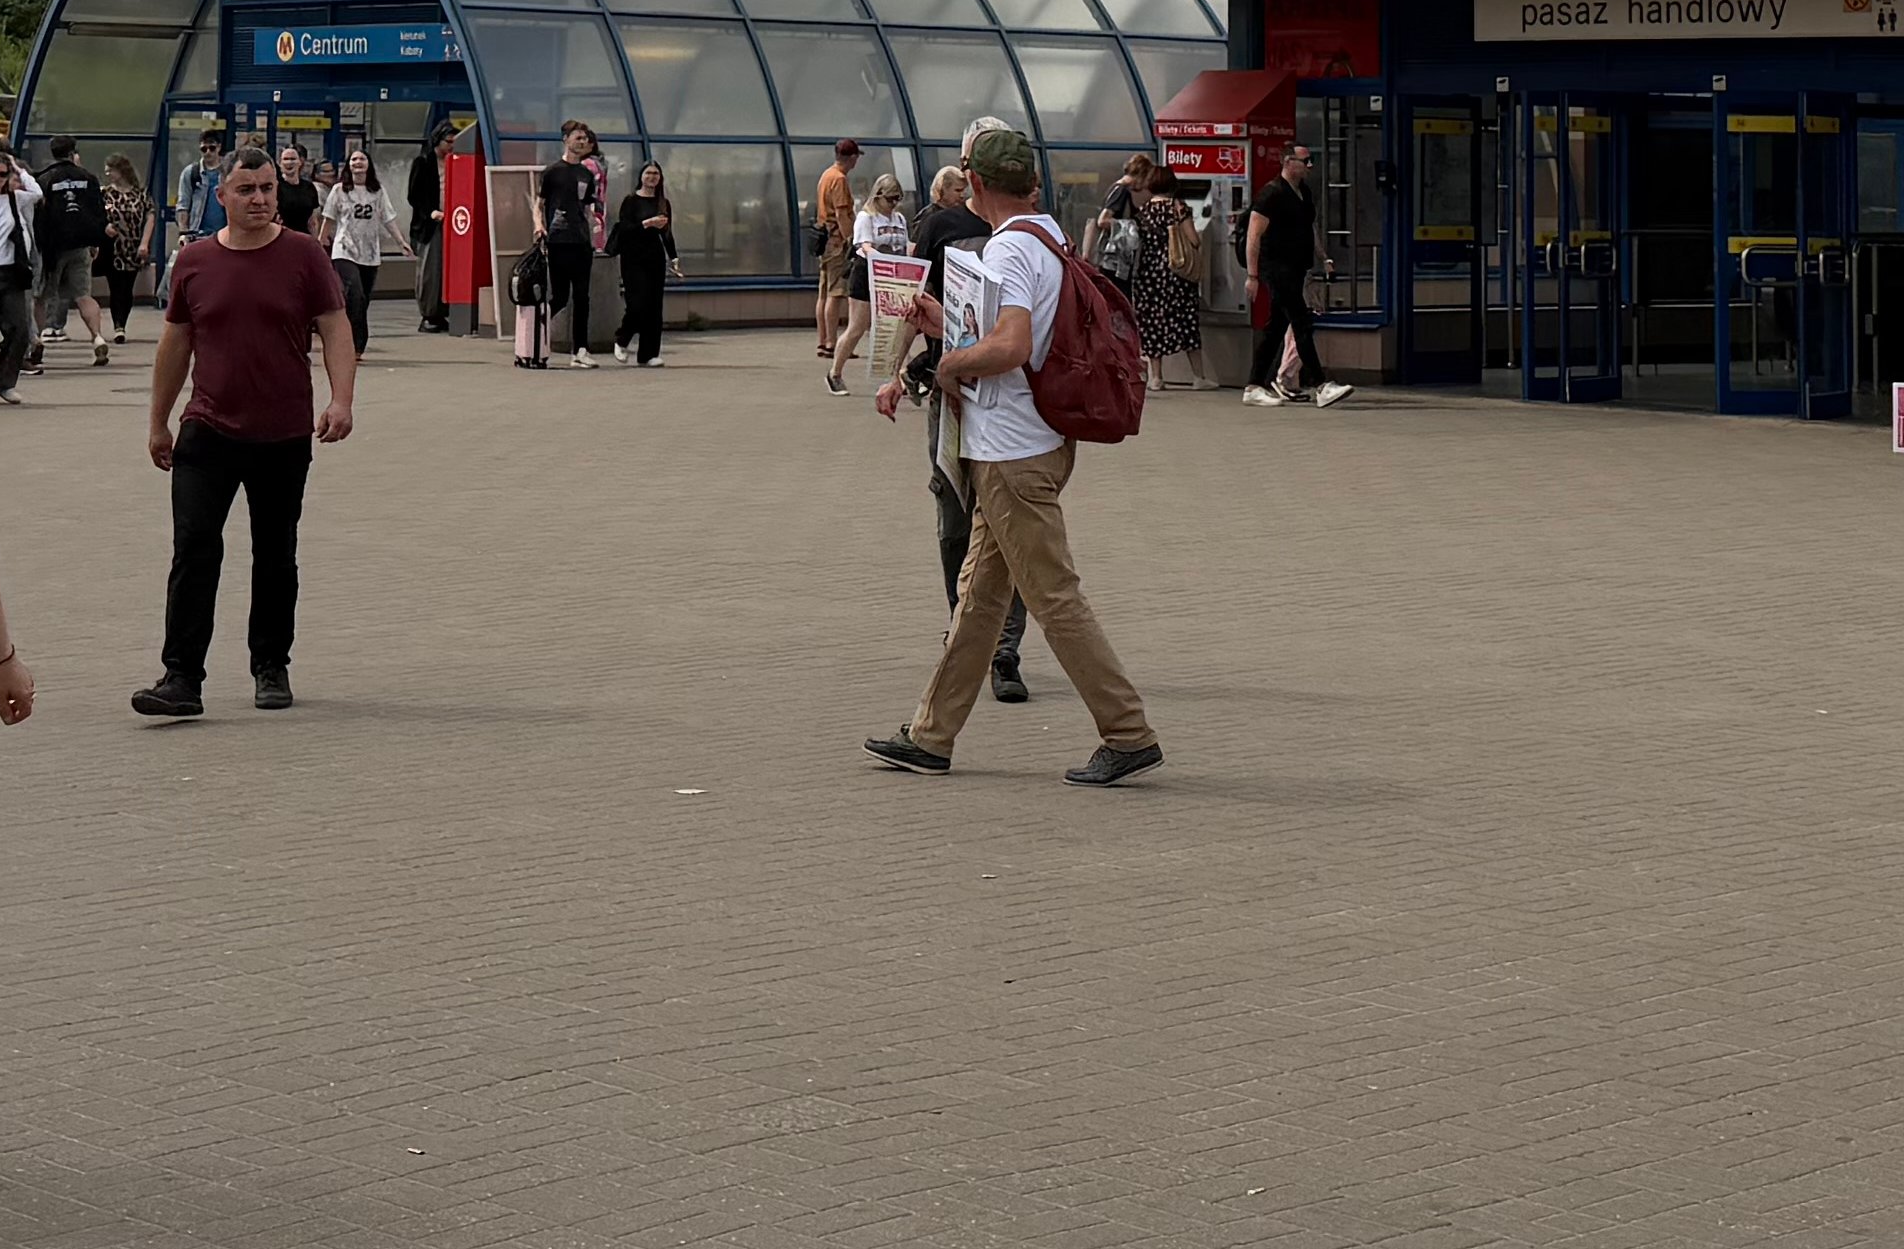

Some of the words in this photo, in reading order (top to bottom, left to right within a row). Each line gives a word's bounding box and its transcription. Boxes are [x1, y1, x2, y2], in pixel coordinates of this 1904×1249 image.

[300, 32, 368, 56] Centrum
[1168, 151, 1202, 168] Bilety
[353, 203, 373, 220] 22
